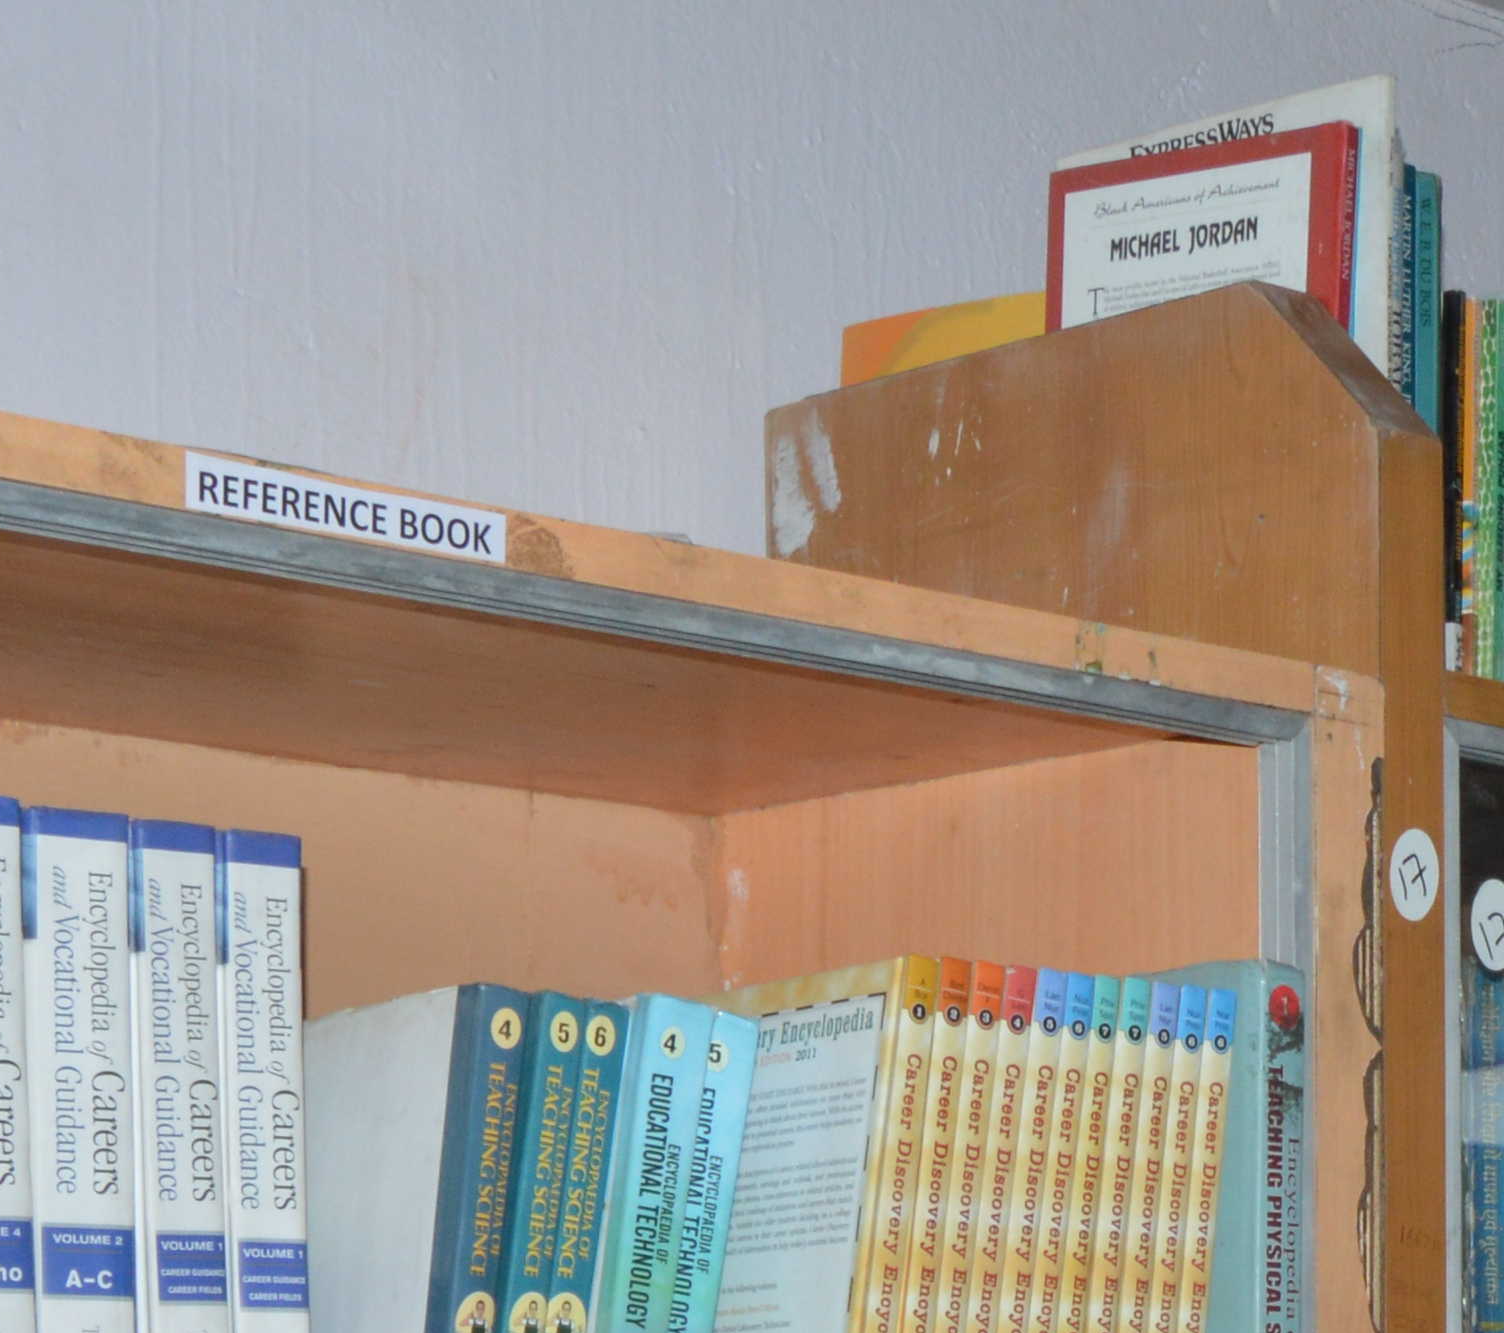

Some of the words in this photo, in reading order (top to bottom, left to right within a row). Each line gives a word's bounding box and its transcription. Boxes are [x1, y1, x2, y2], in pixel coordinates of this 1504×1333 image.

[1110, 230, 1180, 261] MICHAEL
[1189, 217, 1258, 254] JORDAN
[198, 470, 388, 535] REFERENCE
[399, 508, 492, 555] BOOK
[1398, 853, 1427, 900] 17
[594, 1026, 607, 1047] 6
[663, 1033, 677, 1053] 4
[779, 1005, 875, 1046] Encyclopedia
[795, 1047, 817, 1063] 2011
[570, 1068, 600, 1182] TEACHING
[638, 1073, 674, 1197] EDUCATIONAL
[899, 1053, 923, 1132] Career
[1205, 1081, 1224, 1156] Career
[1264, 1063, 1287, 1188] TEACHING
[556, 1188, 584, 1278] SCIENCE
[659, 1144, 681, 1243] ENCYCLOPAEDIA
[882, 1140, 914, 1260] Discovery
[1193, 1162, 1218, 1274] Discovery
[625, 1204, 660, 1329] TECHNOLOGY
[656, 1249, 669, 1265] OF
[1266, 1197, 1284, 1317] PHYSICAL
